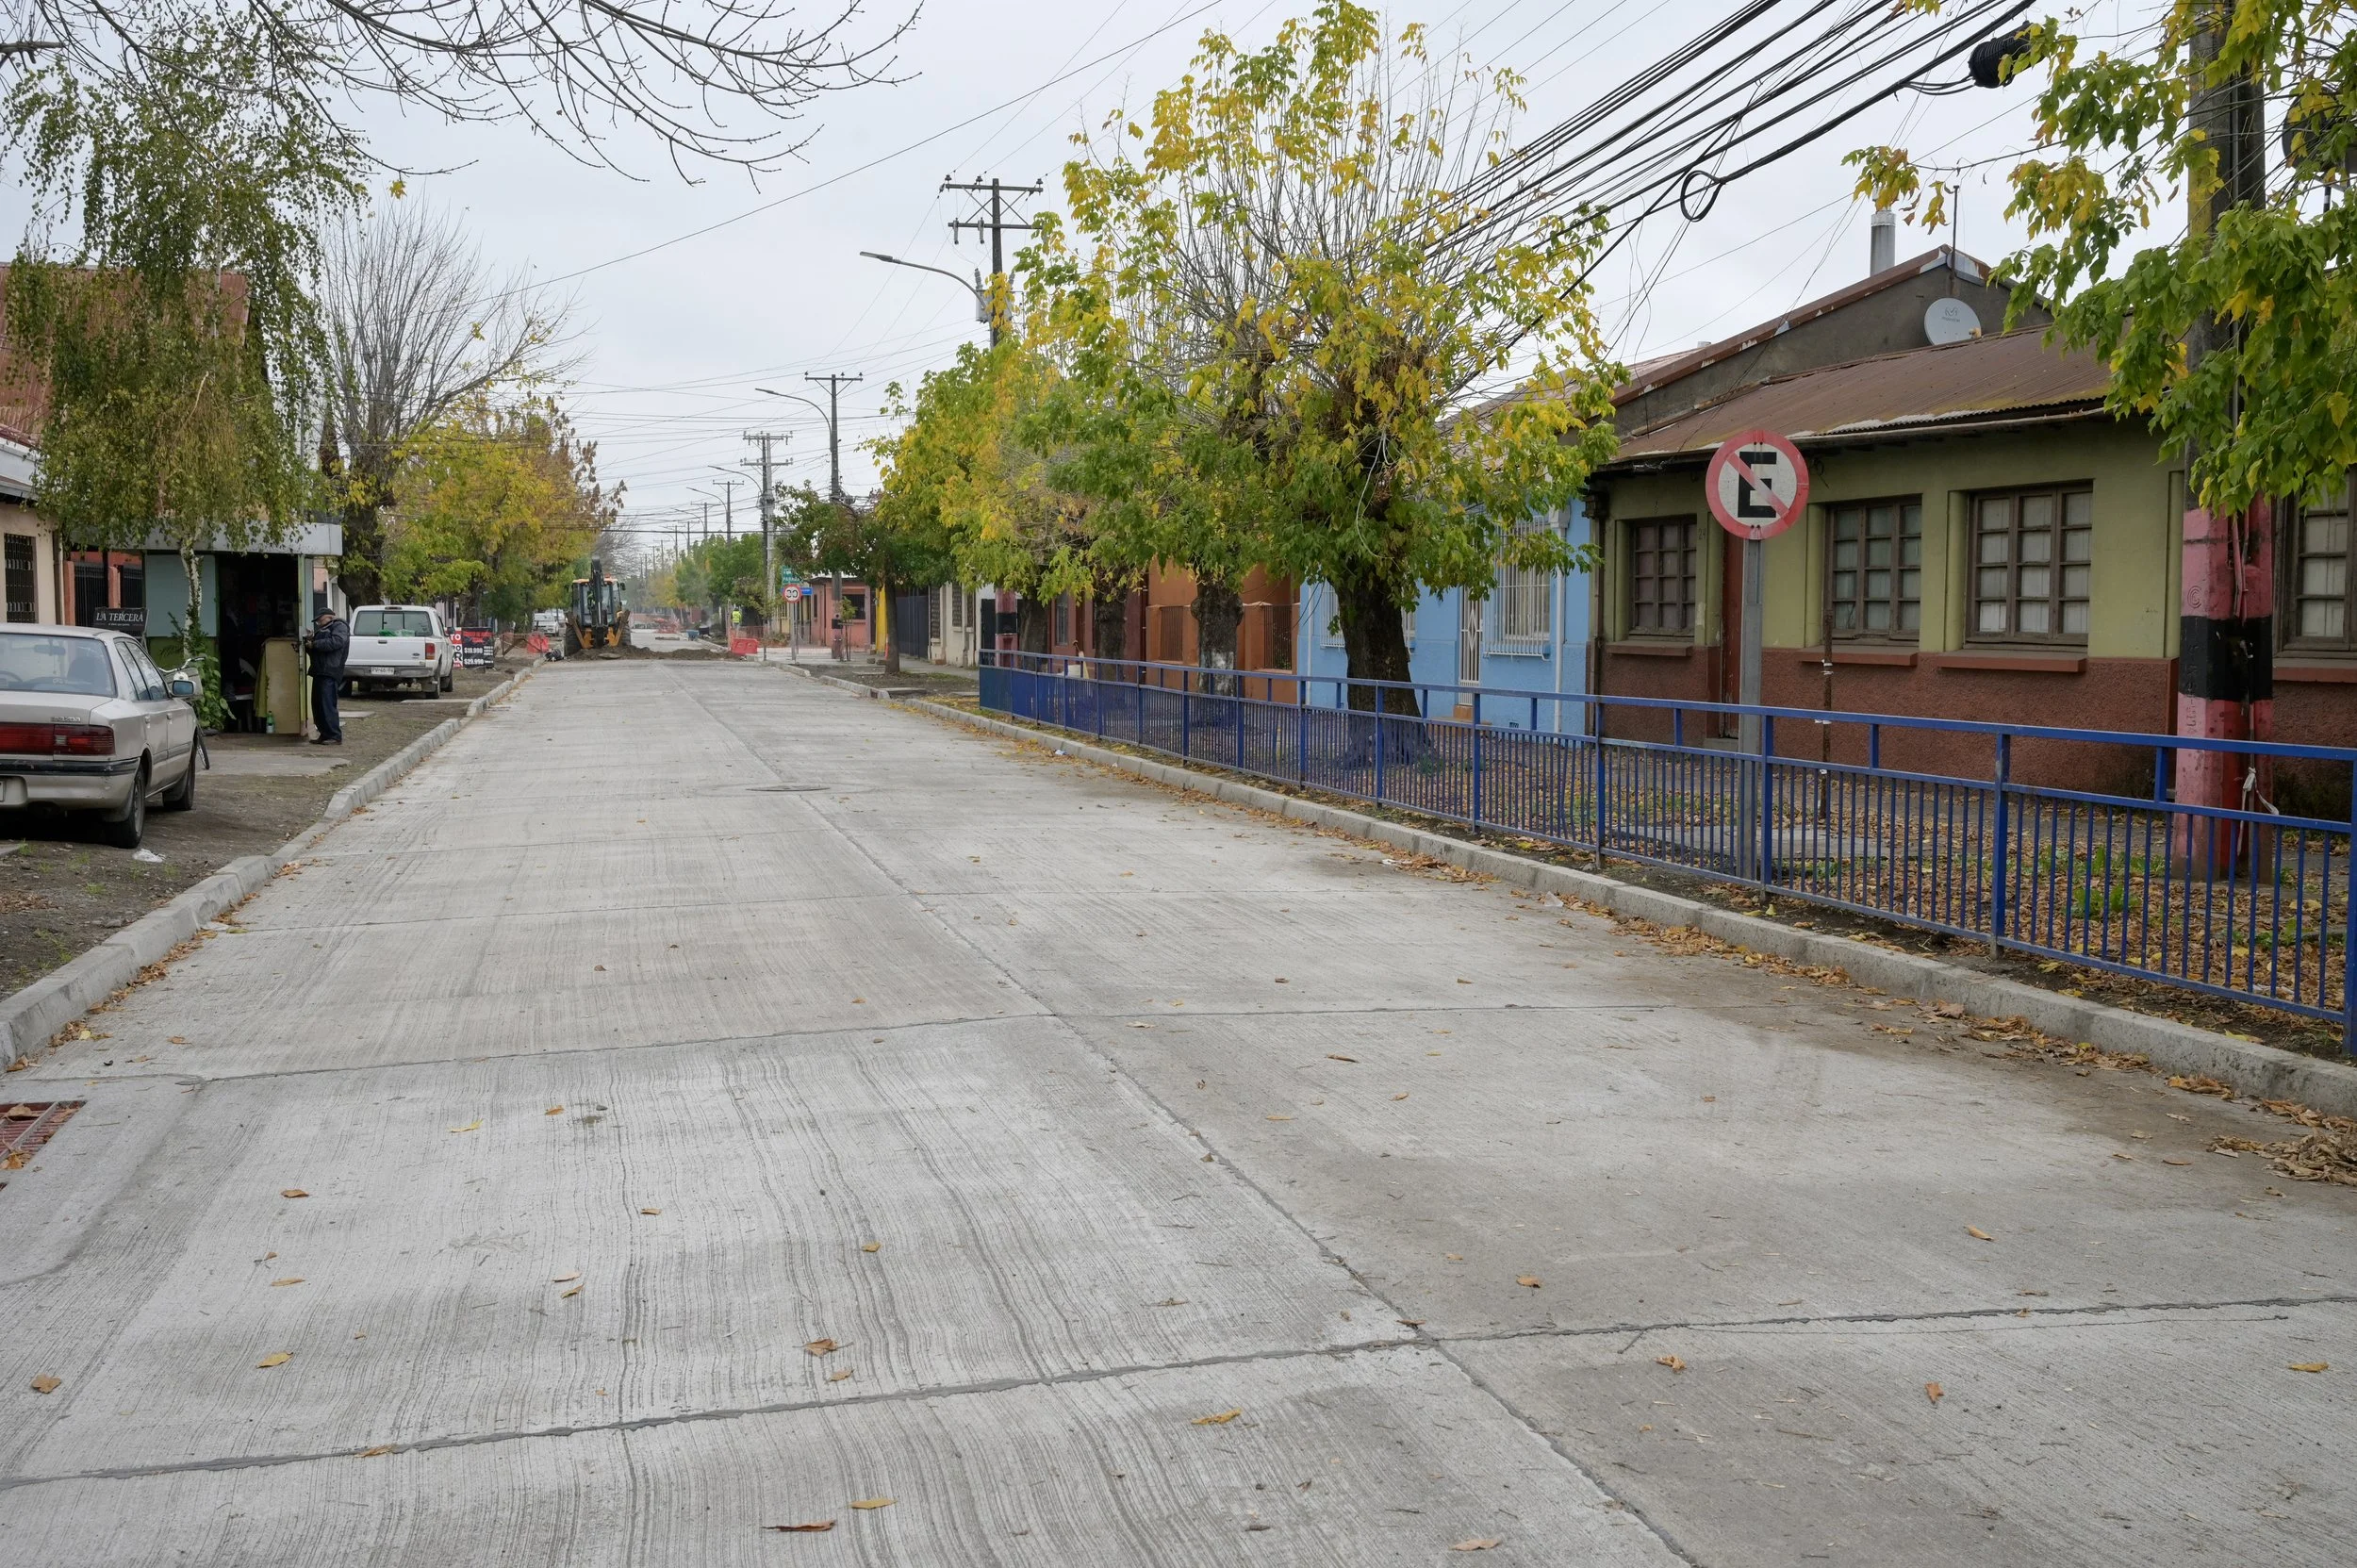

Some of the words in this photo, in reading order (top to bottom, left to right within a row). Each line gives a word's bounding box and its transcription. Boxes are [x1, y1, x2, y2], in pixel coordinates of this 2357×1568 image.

[1738, 451, 1777, 519] E
[786, 589, 799, 598] 30
[96, 612, 107, 620] LA
[109, 612, 143, 621] TERCERA
